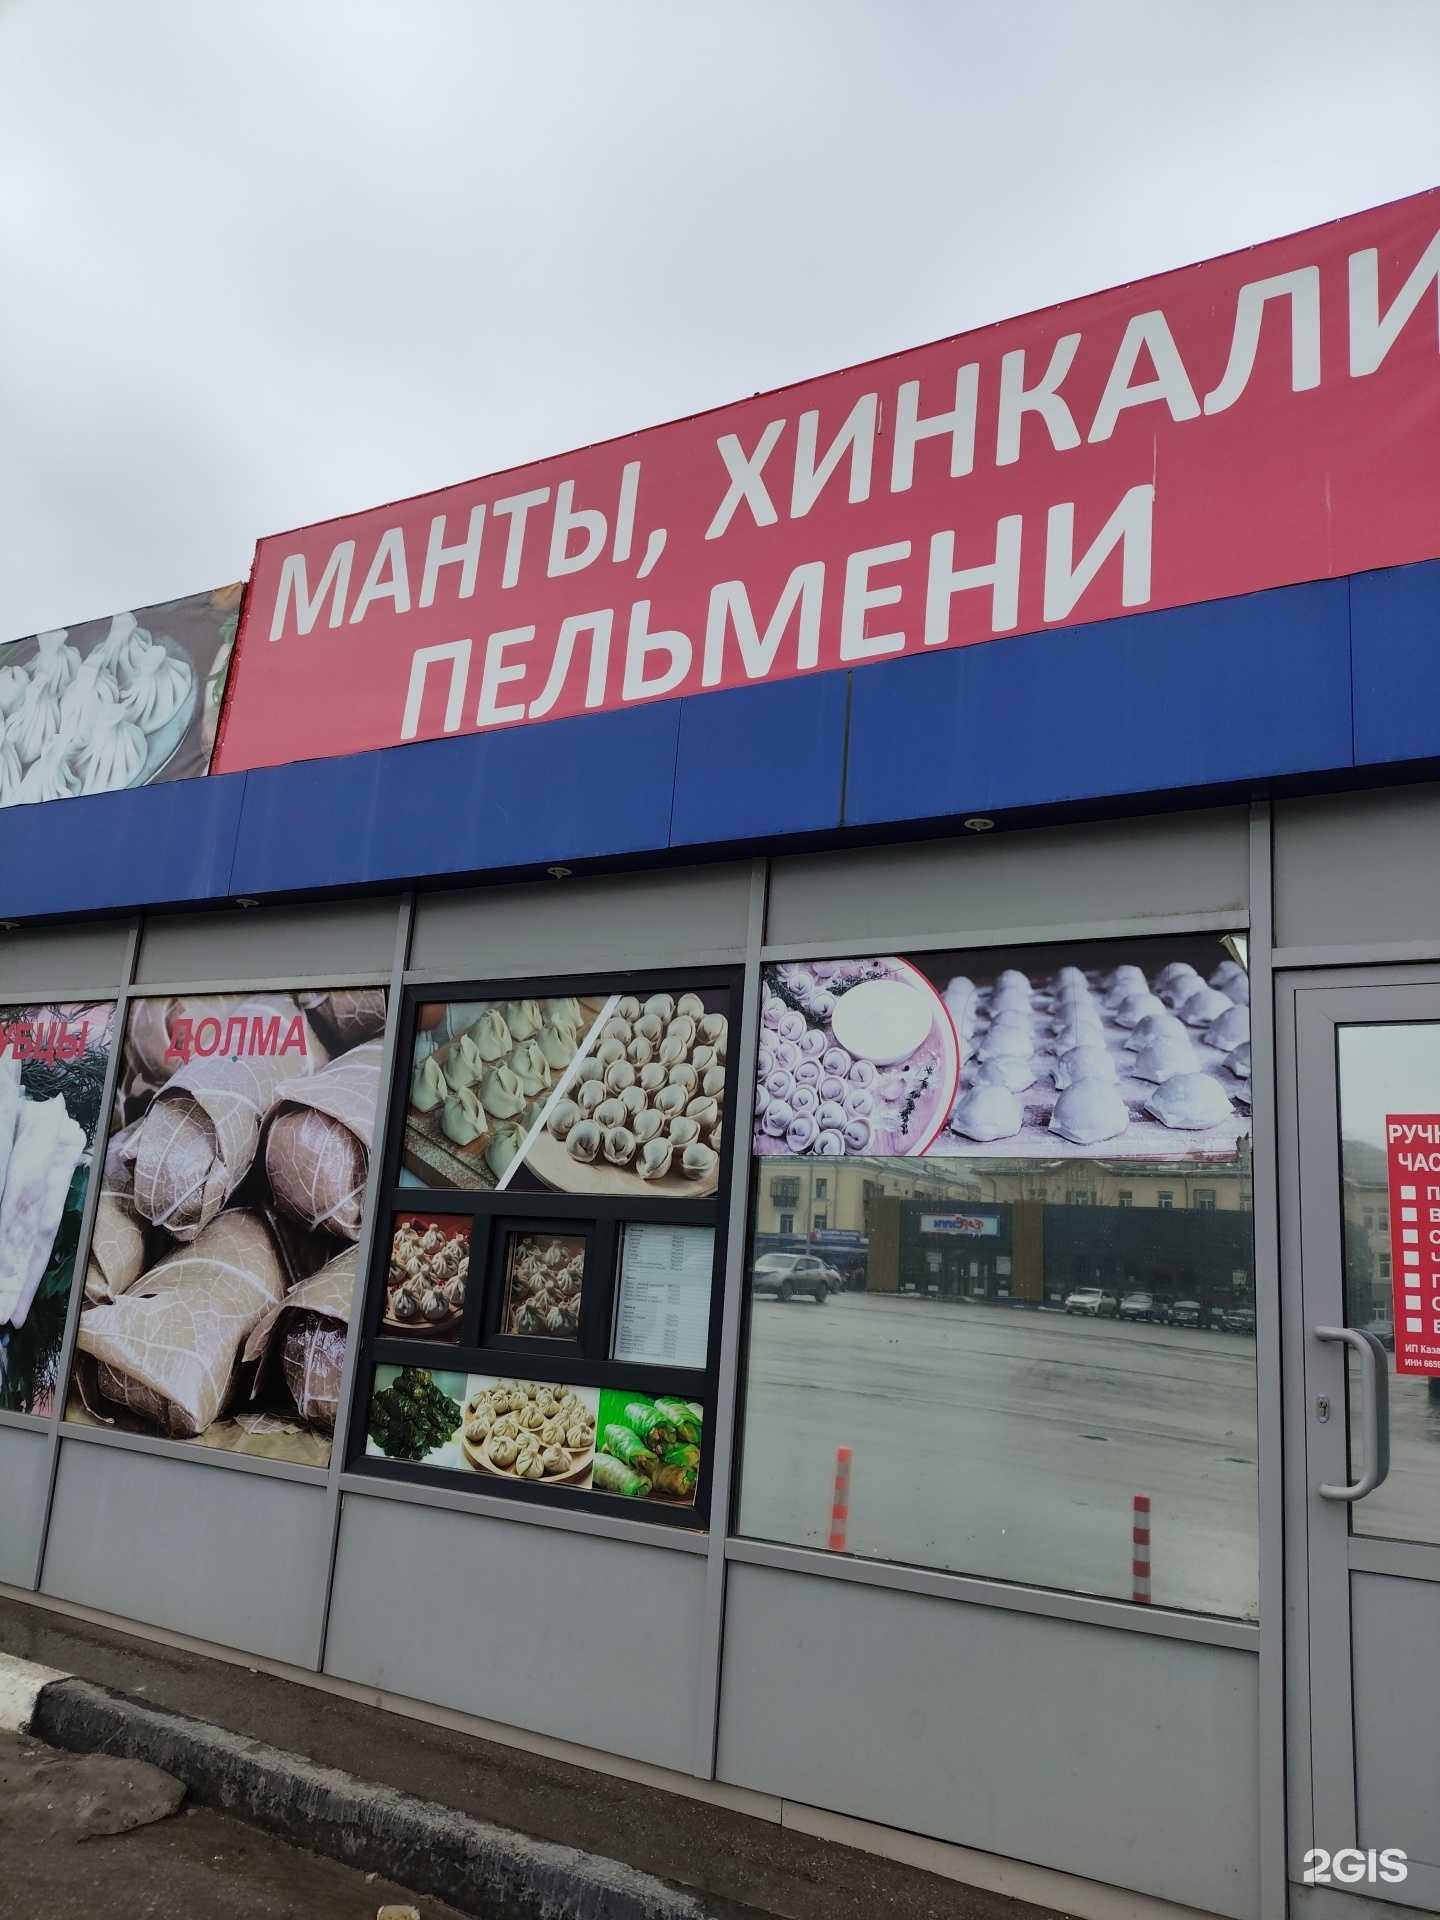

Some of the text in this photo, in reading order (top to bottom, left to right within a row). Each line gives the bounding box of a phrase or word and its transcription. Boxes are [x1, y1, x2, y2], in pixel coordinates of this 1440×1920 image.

[269, 228, 1440, 642] МАНТЫ, ХИНКАЛИ
[400, 484, 1155, 739] ПЕЛЬМЕНИ
[164, 1015, 308, 1064] ДОЛМА
[1405, 1343, 1418, 1353] ИП
